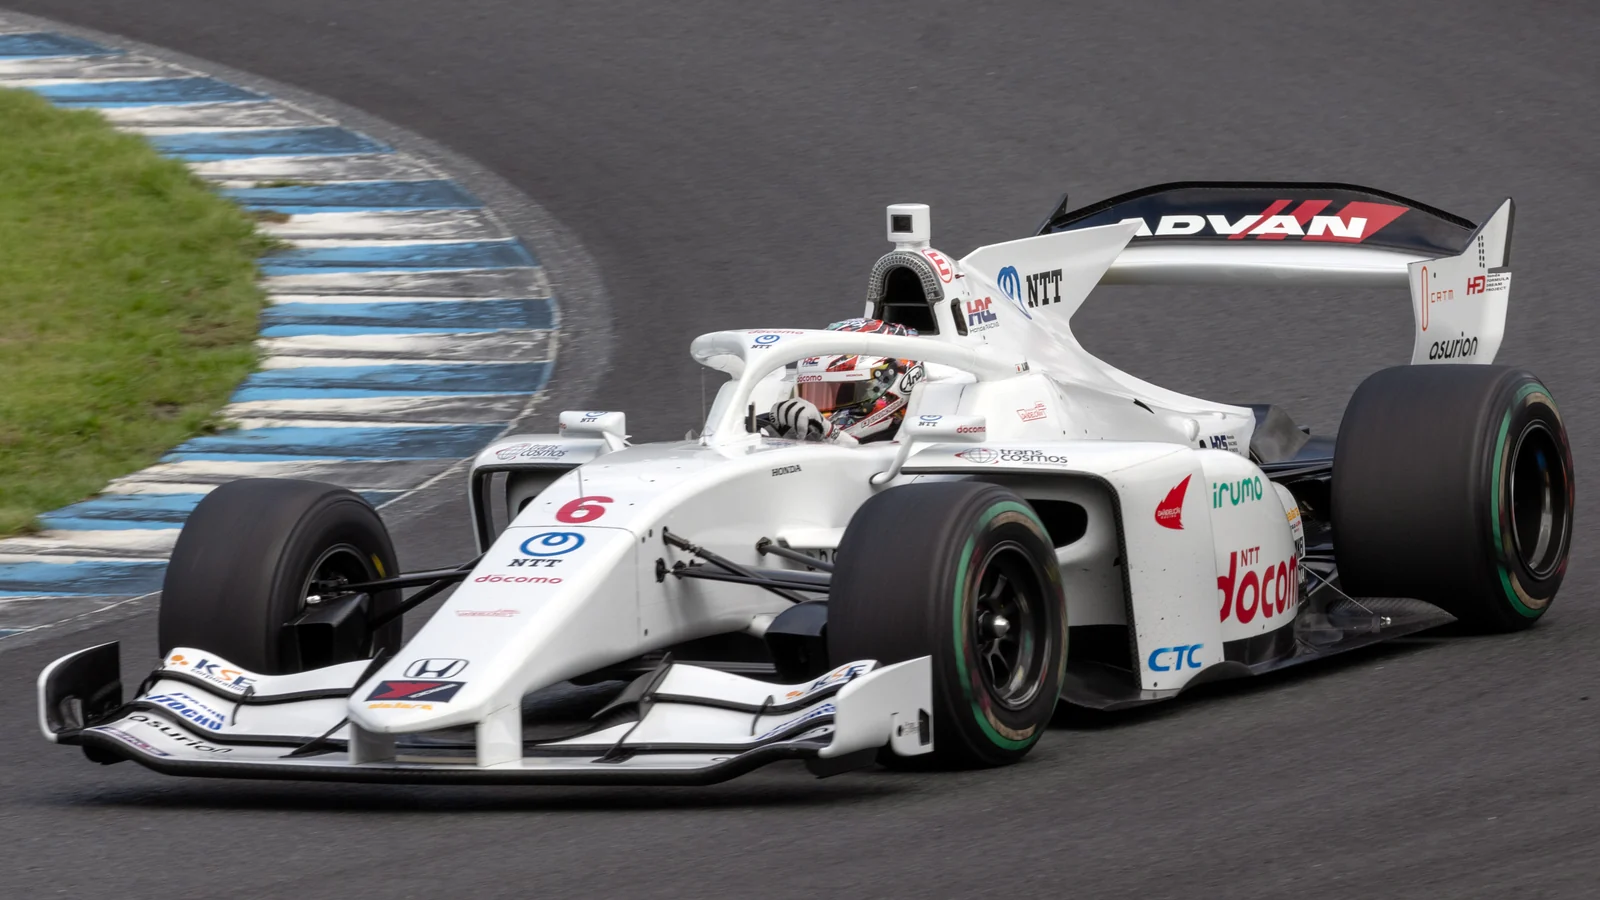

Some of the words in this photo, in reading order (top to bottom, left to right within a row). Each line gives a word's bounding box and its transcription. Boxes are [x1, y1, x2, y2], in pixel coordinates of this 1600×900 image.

[1116, 214, 1368, 239] ADVAN
[1026, 268, 1063, 308] NTT
[1428, 331, 1479, 360] asurion
[1000, 448, 1043, 456] trans
[1000, 454, 1068, 464] cosmos
[771, 464, 802, 477] HONDA
[1212, 475, 1263, 509] irumo
[555, 495, 615, 524] 6
[506, 558, 563, 568] NTT
[1240, 546, 1260, 567] NTT
[473, 574, 564, 584] docomo
[1147, 643, 1204, 672] CTC
[127, 715, 233, 754] asurion
